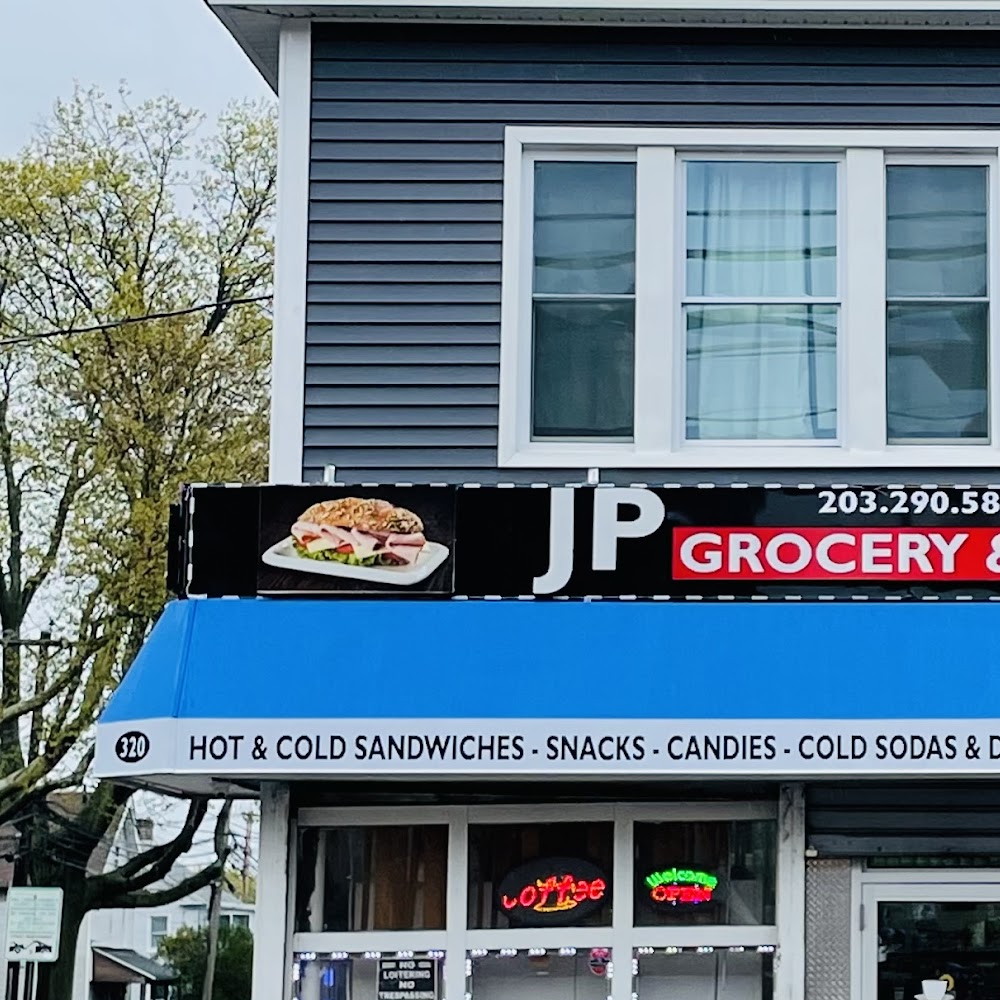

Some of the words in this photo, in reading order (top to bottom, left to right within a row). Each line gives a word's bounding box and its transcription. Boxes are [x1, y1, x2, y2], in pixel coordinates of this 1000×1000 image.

[532, 486, 666, 595] JP
[680, 533, 969, 573] GROCERY
[190, 735, 244, 760] HOT
[252, 735, 268, 760] &
[277, 735, 347, 760] COLD
[355, 735, 524, 761] SANDWICHES
[547, 735, 645, 761] SNACKS
[667, 735, 776, 760] CANDIES
[798, 735, 867, 760] COLD
[876, 735, 957, 760] SODAS
[965, 735, 981, 760] &
[399, 980, 415, 989] NO
